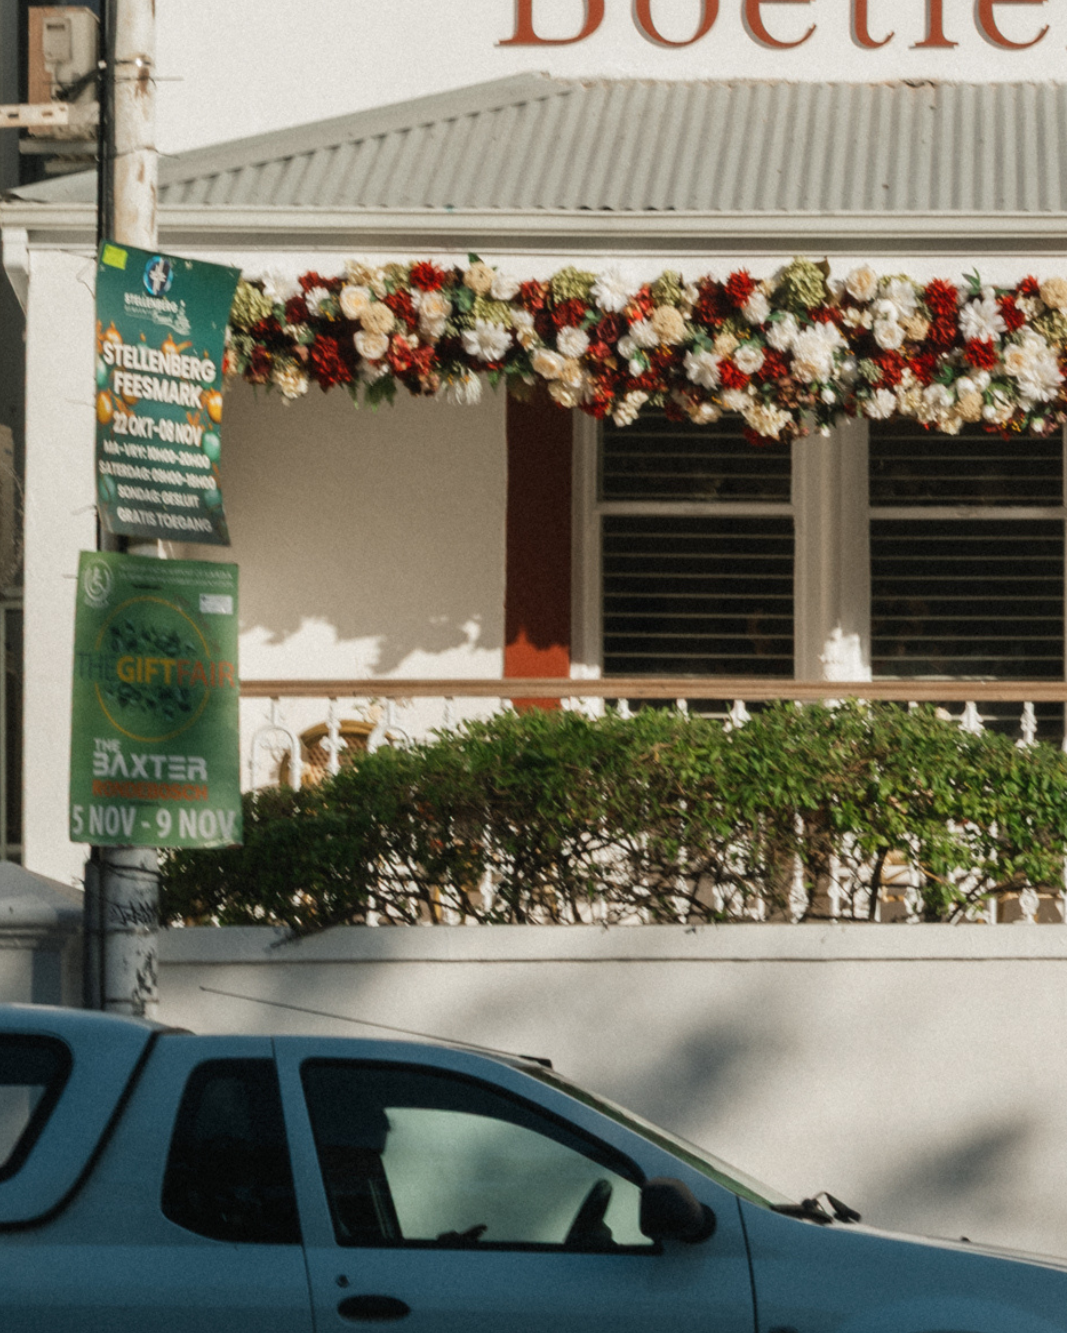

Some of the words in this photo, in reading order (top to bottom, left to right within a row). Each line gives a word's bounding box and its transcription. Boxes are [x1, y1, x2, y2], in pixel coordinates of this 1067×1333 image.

[103, 340, 216, 384] STELLENBERG
[113, 370, 203, 410] FEESMARK
[113, 410, 129, 435] 22
[175, 422, 203, 447] NOV
[161, 490, 200, 508] GESLUIT
[116, 506, 157, 527] GRATIS
[157, 512, 213, 533] TOEGANG
[116, 656, 176, 685] GIFT
[177, 659, 236, 688] FAIR
[93, 751, 208, 781] BAXTER
[92, 779, 208, 801] RONDEBOSCH
[72, 804, 84, 835] 5
[89, 805, 137, 837] NOV
[156, 808, 172, 839] 9
[179, 809, 237, 841] NOV
